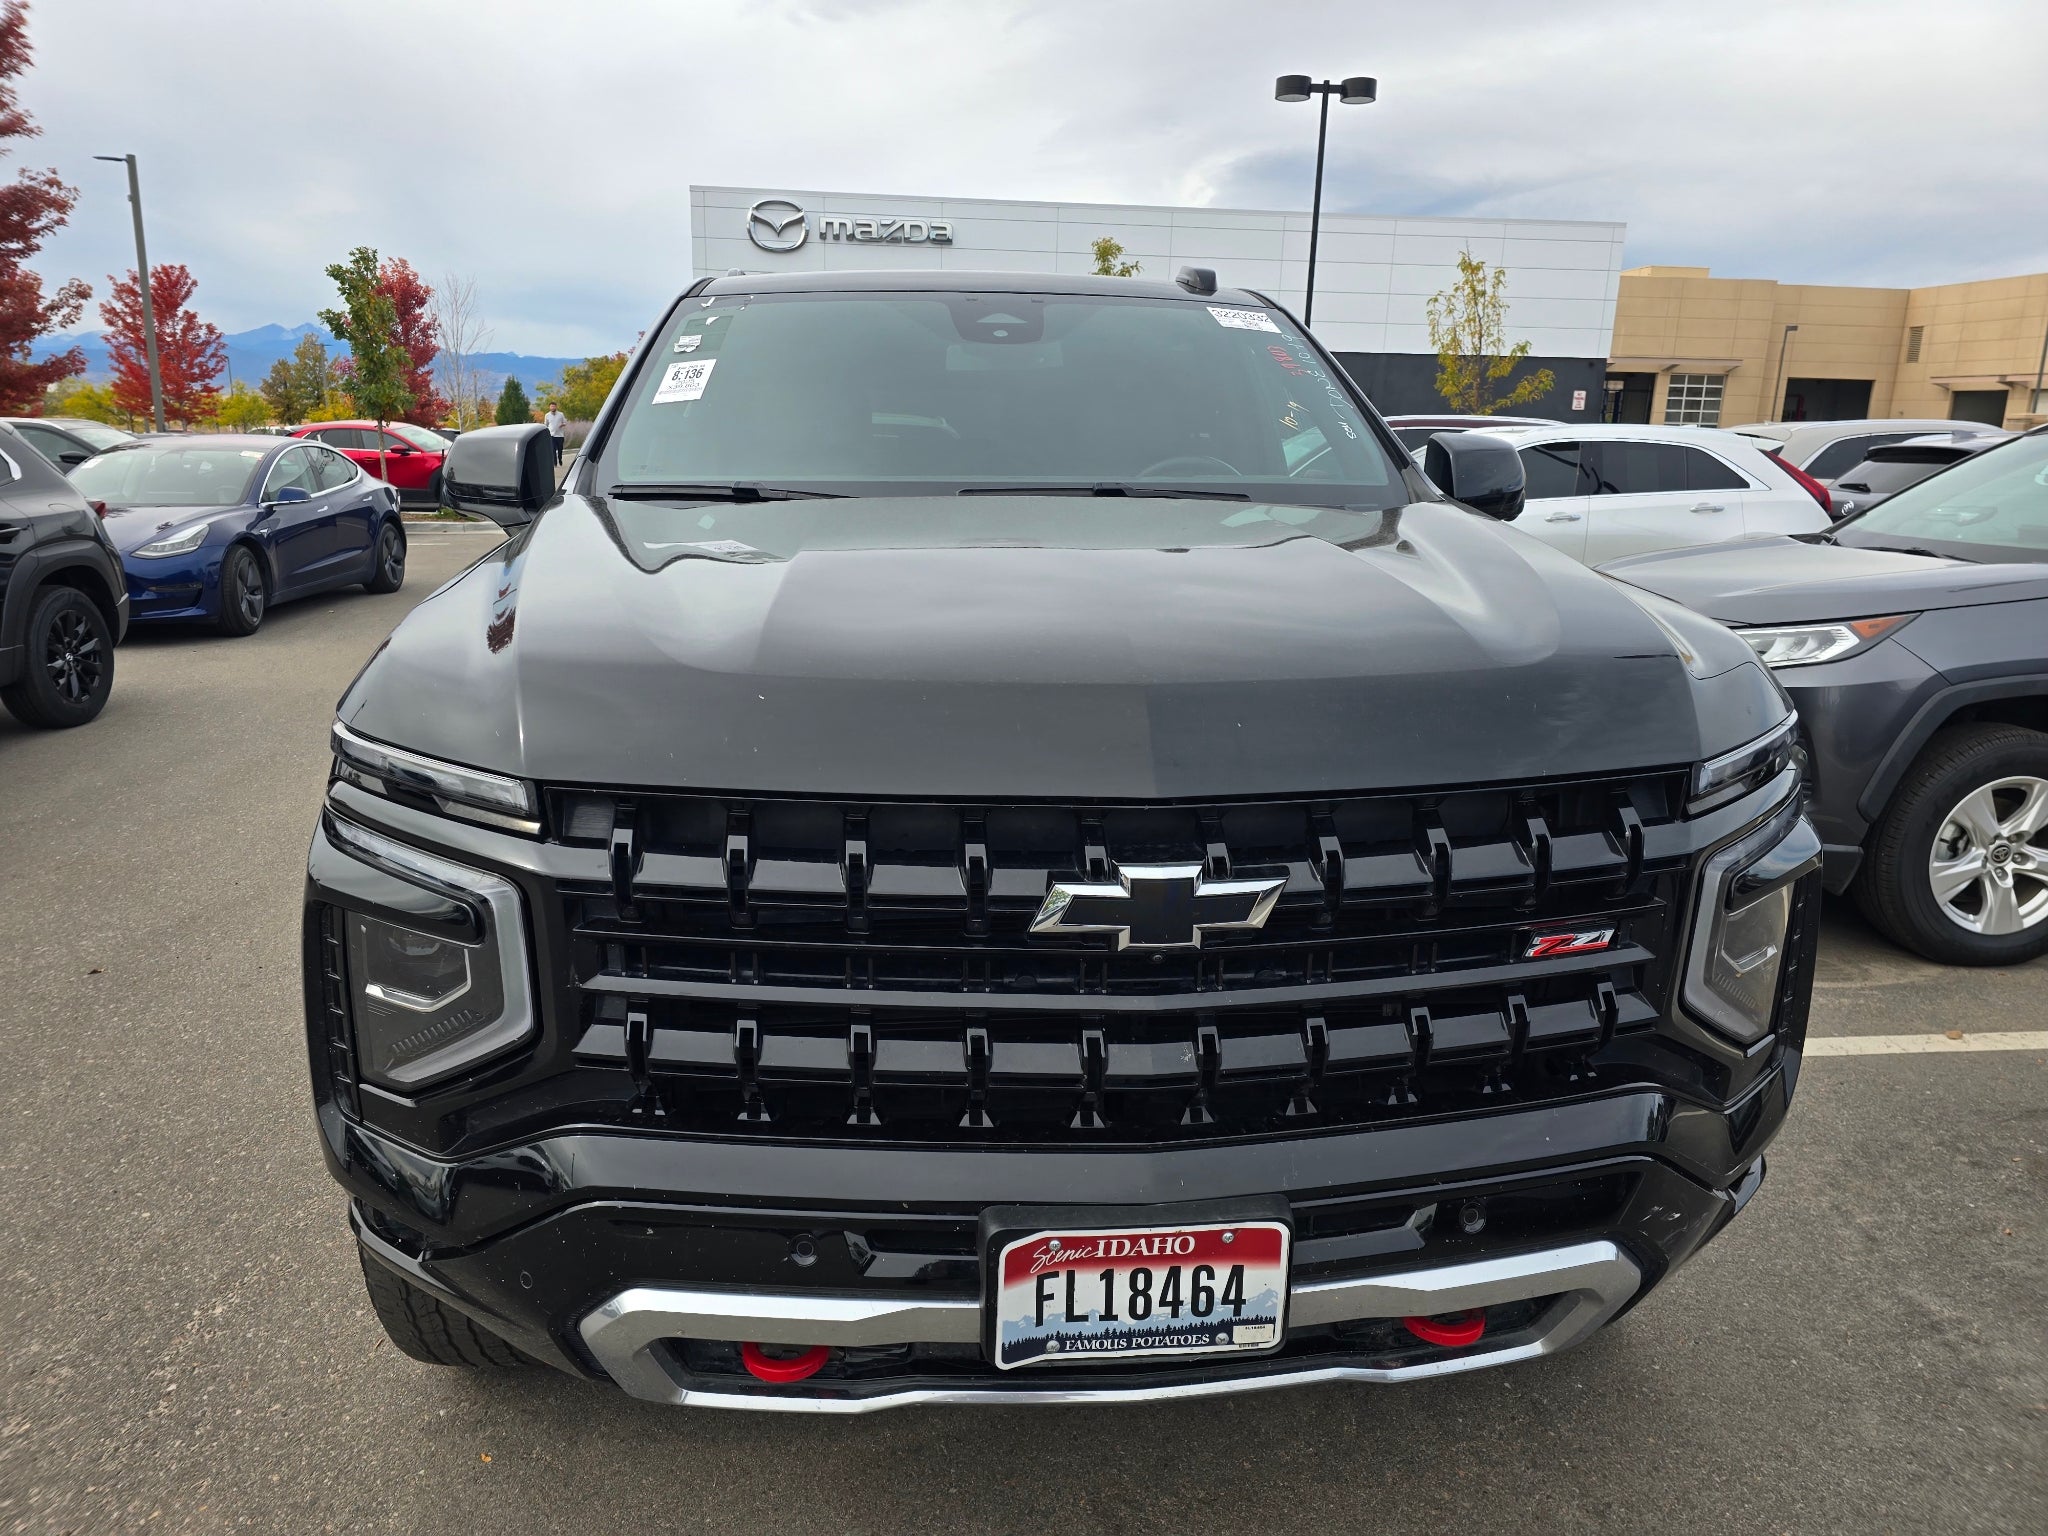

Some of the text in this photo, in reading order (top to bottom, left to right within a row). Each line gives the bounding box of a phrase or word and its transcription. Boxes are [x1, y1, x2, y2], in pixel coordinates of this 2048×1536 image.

[1525, 928, 1615, 957] Z71
[1030, 1235, 1196, 1274] Scenic IDAHO
[1035, 1264, 1247, 1328] FL18464
[1065, 1333, 1210, 1351] FAMOUS POTATOES
